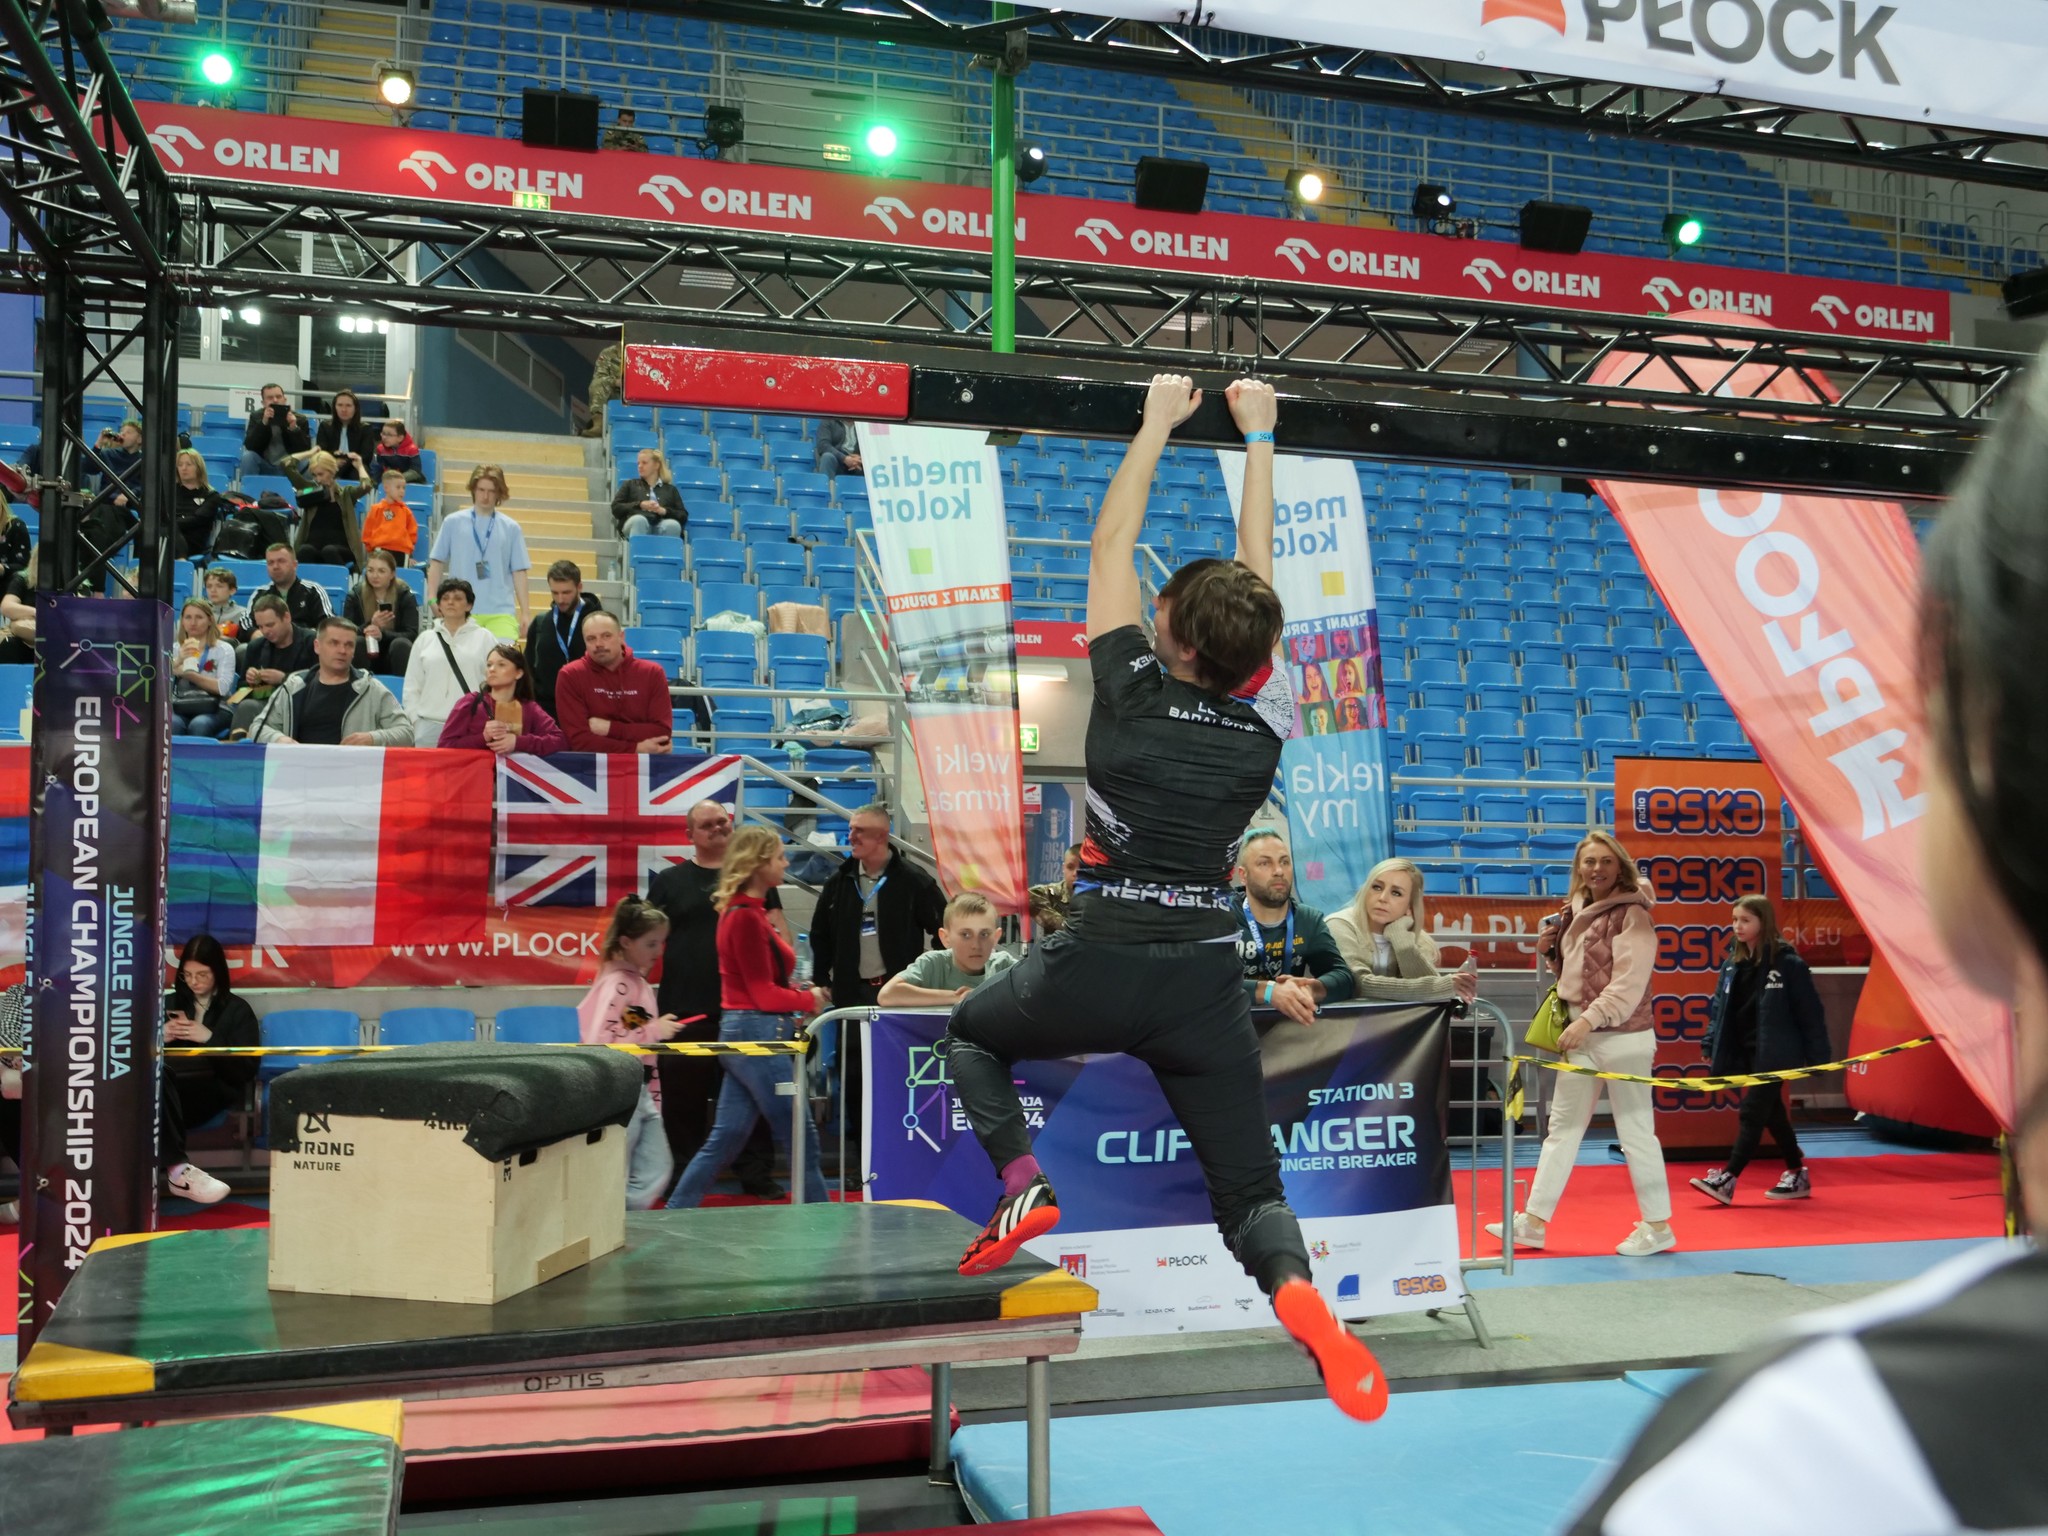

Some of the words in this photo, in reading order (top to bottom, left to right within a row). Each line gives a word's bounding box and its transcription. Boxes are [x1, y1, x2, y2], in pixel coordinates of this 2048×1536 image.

[213, 137, 340, 176] ORLEN
[464, 162, 583, 199] ORLEN
[700, 186, 812, 221] ORLEN
[1129, 229, 1229, 262] ORLEN
[1326, 248, 1420, 280] ORLEN
[1511, 268, 1601, 299] ORLEN
[1688, 288, 1772, 318] ORLEN
[1854, 305, 1935, 335] ORLEN
[1014, 633, 1042, 644] RLEN
[72, 695, 101, 891] EUROPEAN
[1636, 797, 1646, 824] radio
[1650, 792, 1761, 832] eska
[1651, 861, 1762, 899] eska
[1101, 883, 1230, 911] REPUBLIC
[111, 884, 134, 991] JUNGLE
[1656, 929, 1734, 968] esk
[1782, 926, 1841, 946] CK.EU
[66, 899, 98, 1171] CHAMPIONSHIP
[109, 998, 132, 1080] NINJA
[1307, 1084, 1394, 1106] STATION
[1399, 1082, 1414, 1099] 3
[281, 1142, 355, 1156] TRONG
[1279, 1156, 1335, 1172] INGER
[1338, 1151, 1417, 1169] BREAKER
[293, 1160, 341, 1172] NATURE
[63, 1178, 93, 1271] 2024
[1168, 1254, 1208, 1268] PŁOCK
[1398, 1274, 1447, 1296] eska
[524, 1372, 604, 1391] OPTIS
